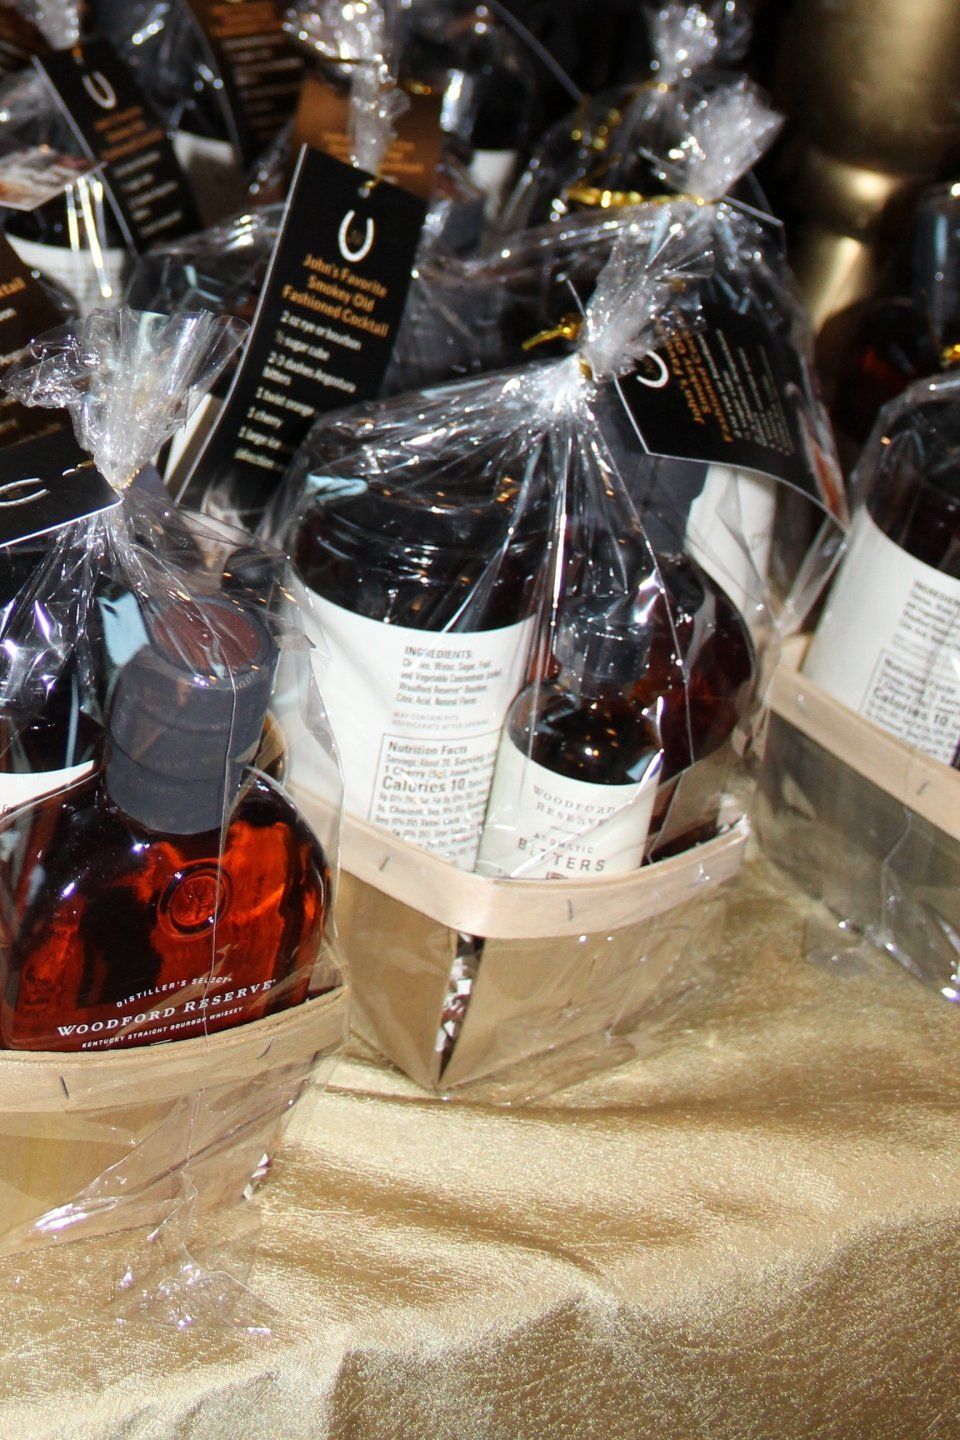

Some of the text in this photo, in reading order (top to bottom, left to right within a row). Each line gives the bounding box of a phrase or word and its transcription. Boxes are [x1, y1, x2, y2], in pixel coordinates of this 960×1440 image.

[303, 254, 387, 298] John's Favorite
[308, 275, 375, 312] Smokey Old
[282, 284, 389, 337] Fashioned Cocktail
[281, 310, 362, 349] 2 oz rye or bourbon
[282, 337, 308, 353] sugar
[307, 344, 330, 360] cube
[284, 359, 315, 376] dashes
[314, 369, 356, 392] Angostura
[388, 741, 468, 755] Nutrition Facts
[383, 776, 446, 793] Calories
[451, 778, 466, 791] 10
[536, 801, 608, 826] RESERVE
[57, 979, 274, 1037] WOODFORD RESERVE
[116, 979, 187, 1009] DISTILLER'S
[82, 1006, 244, 1049] KENTUCKY STRAIGHT BOURBON WHISKEY
